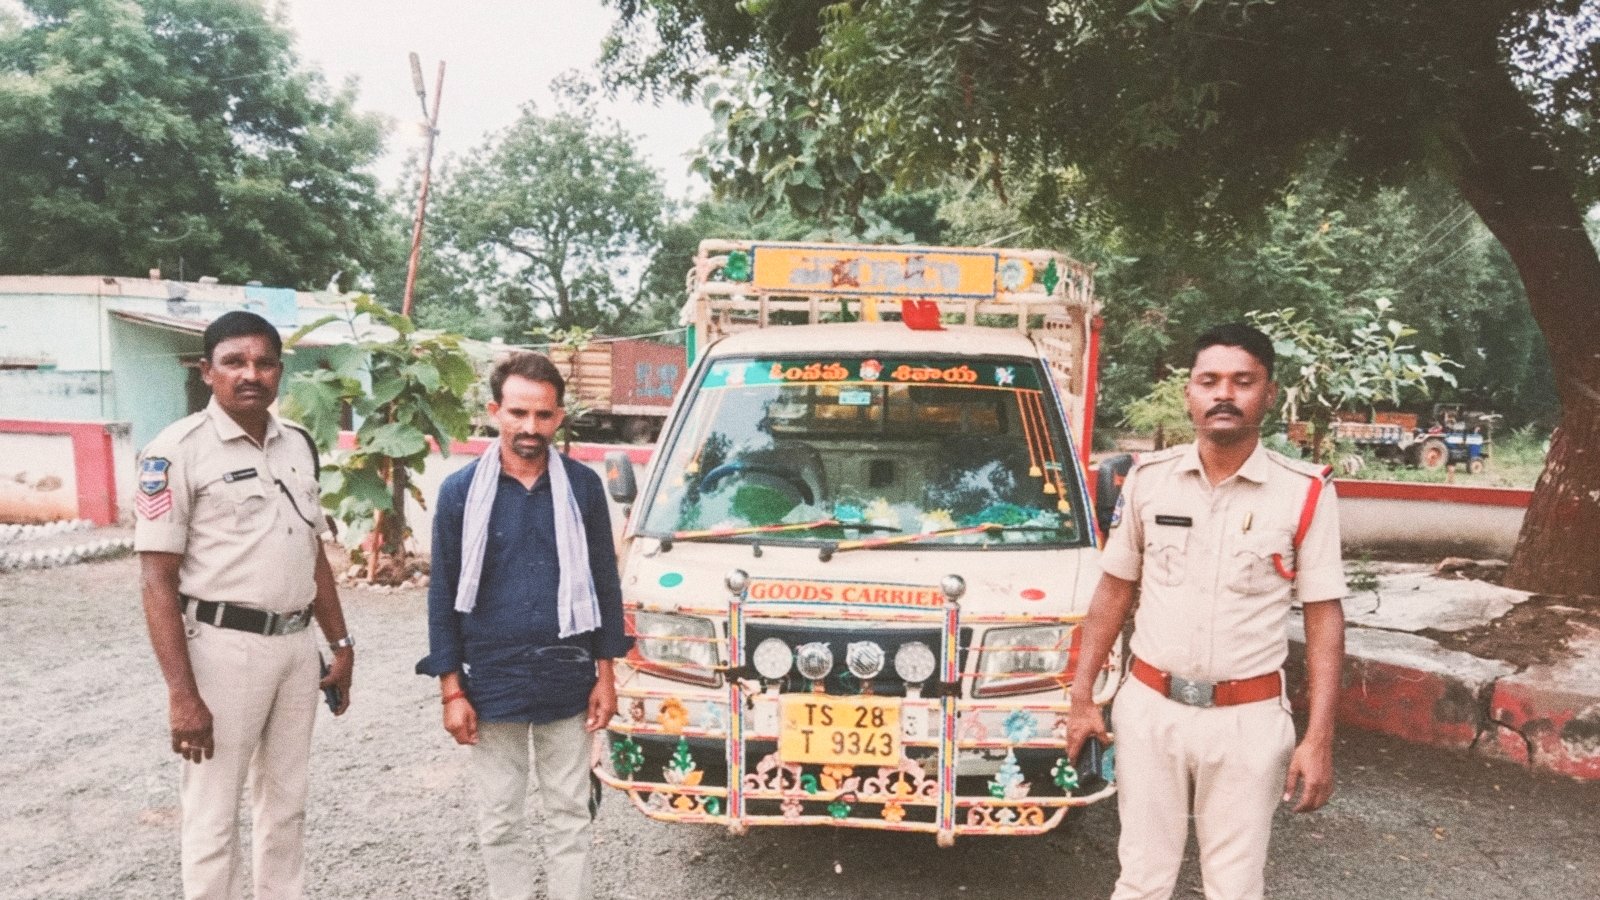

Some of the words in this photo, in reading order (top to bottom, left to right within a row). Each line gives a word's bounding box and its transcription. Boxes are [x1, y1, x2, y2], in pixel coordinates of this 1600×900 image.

[751, 583, 833, 601] GOODS
[805, 703, 833, 727] TS
[855, 706, 884, 728] 28
[801, 730, 814, 754] T
[831, 731, 893, 757] 9343
